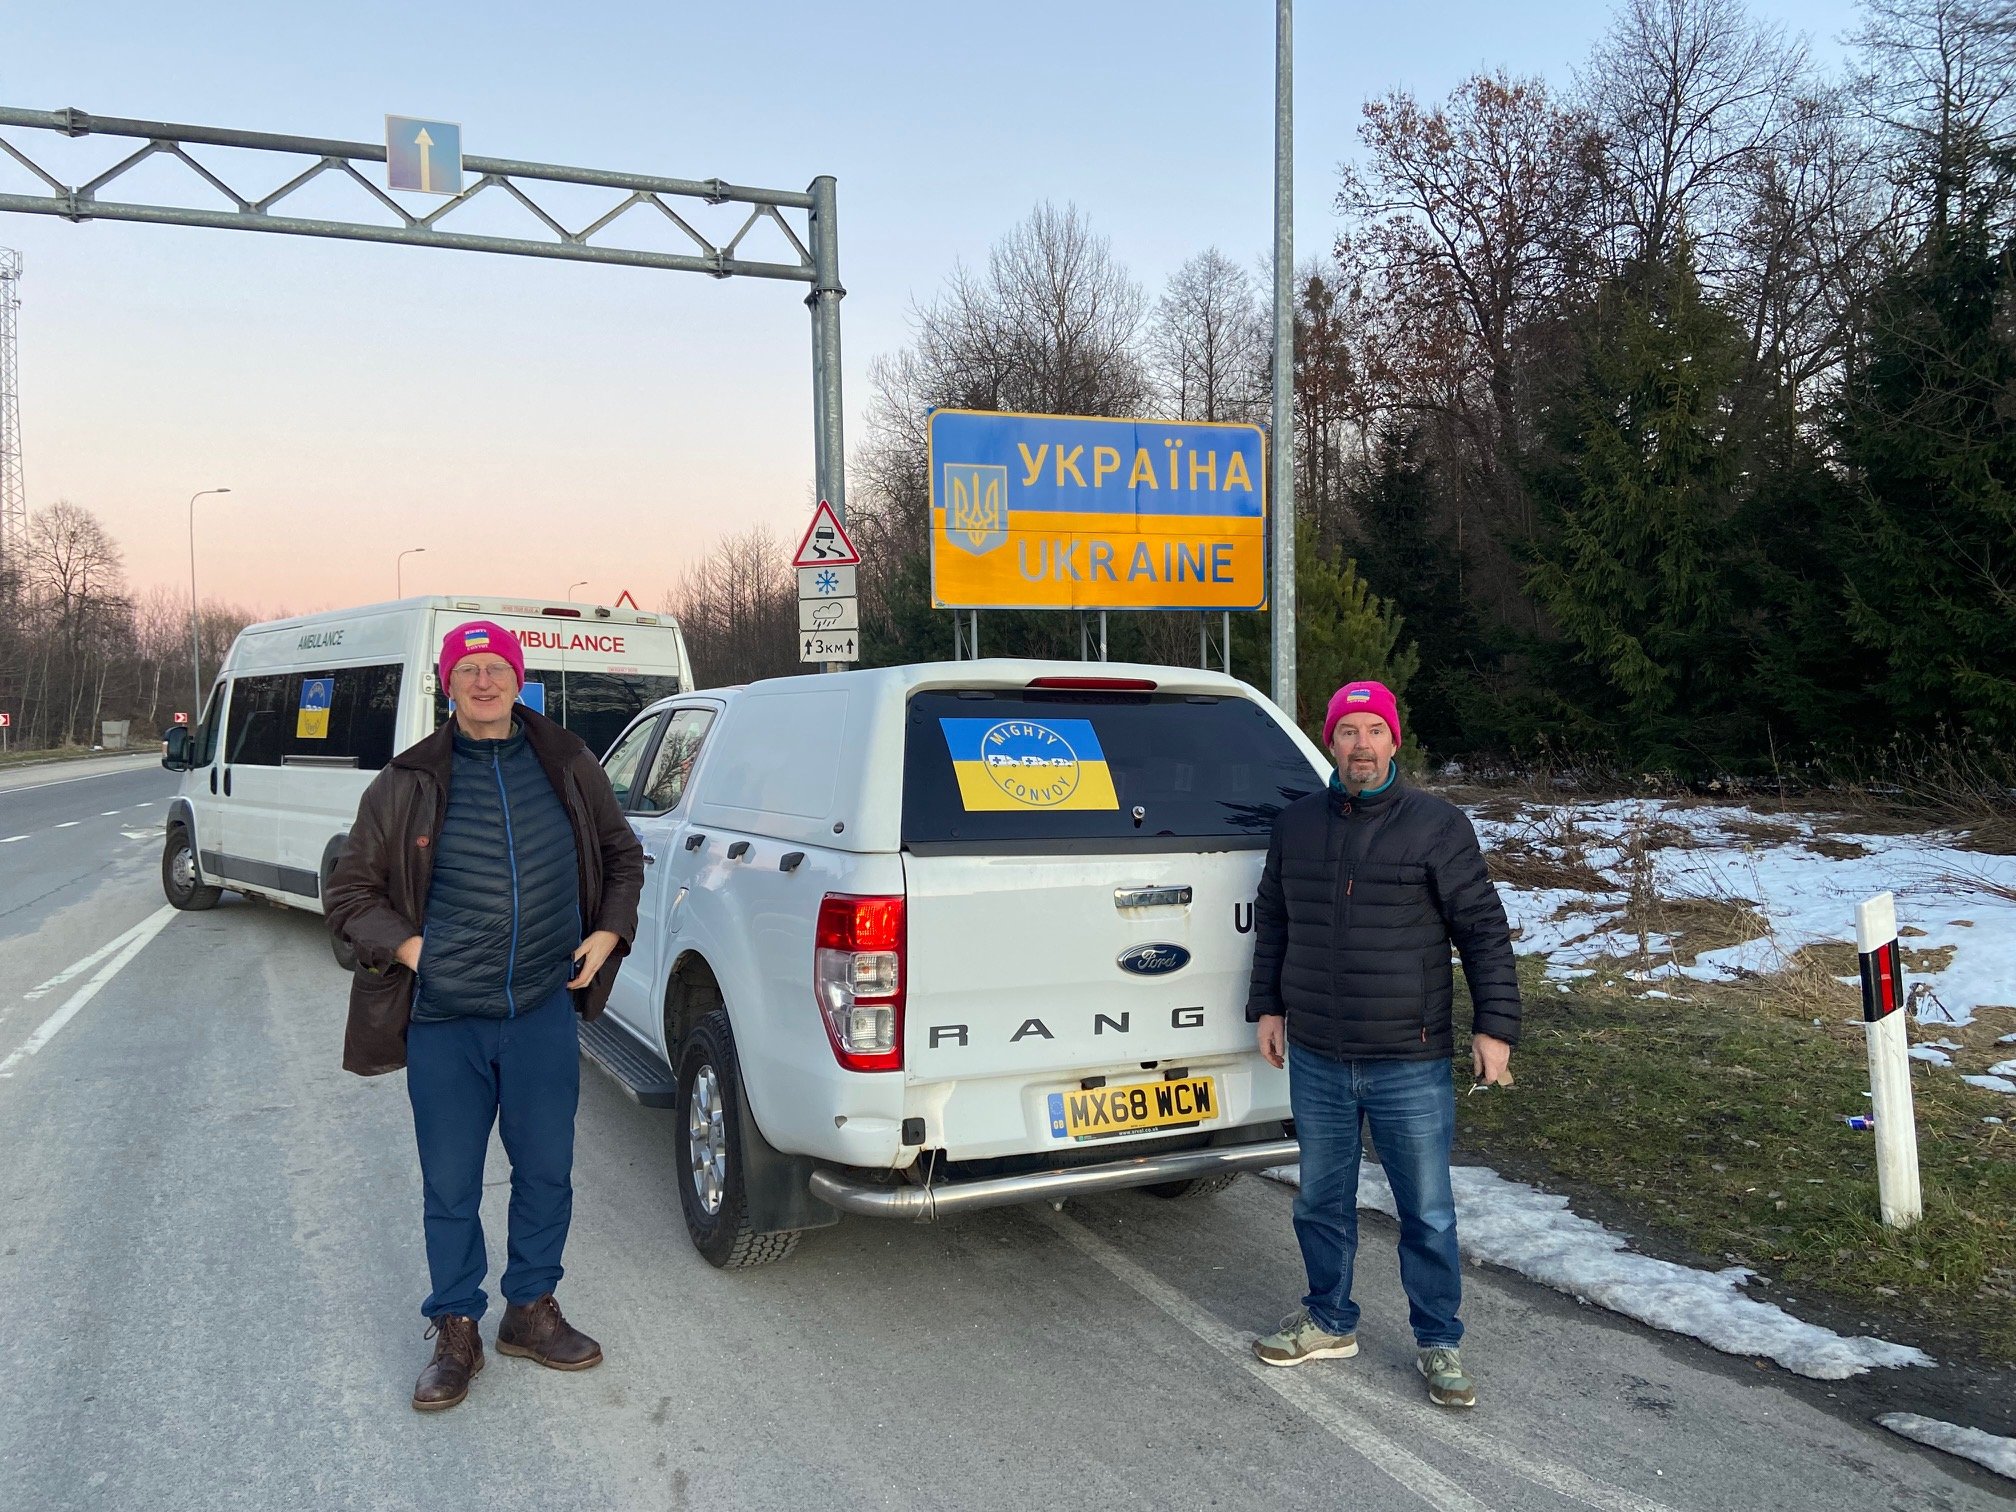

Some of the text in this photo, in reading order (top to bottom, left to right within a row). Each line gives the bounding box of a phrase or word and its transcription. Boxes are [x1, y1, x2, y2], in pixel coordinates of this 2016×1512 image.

[1017, 438, 1253, 492] УКРАЇНА
[1018, 539, 1235, 583] UKRAINE
[297, 630, 344, 650] AMBULANCE
[510, 630, 625, 653] MBULANCE
[990, 725, 1058, 746] MIGHTY
[1004, 776, 1071, 801] CONVOY
[1234, 902, 1257, 934] U
[1137, 949, 1177, 970] Ford
[929, 1006, 1204, 1049] RANG
[1070, 1082, 1211, 1128] MX68 WCW
[1053, 1119, 1065, 1130] GB
